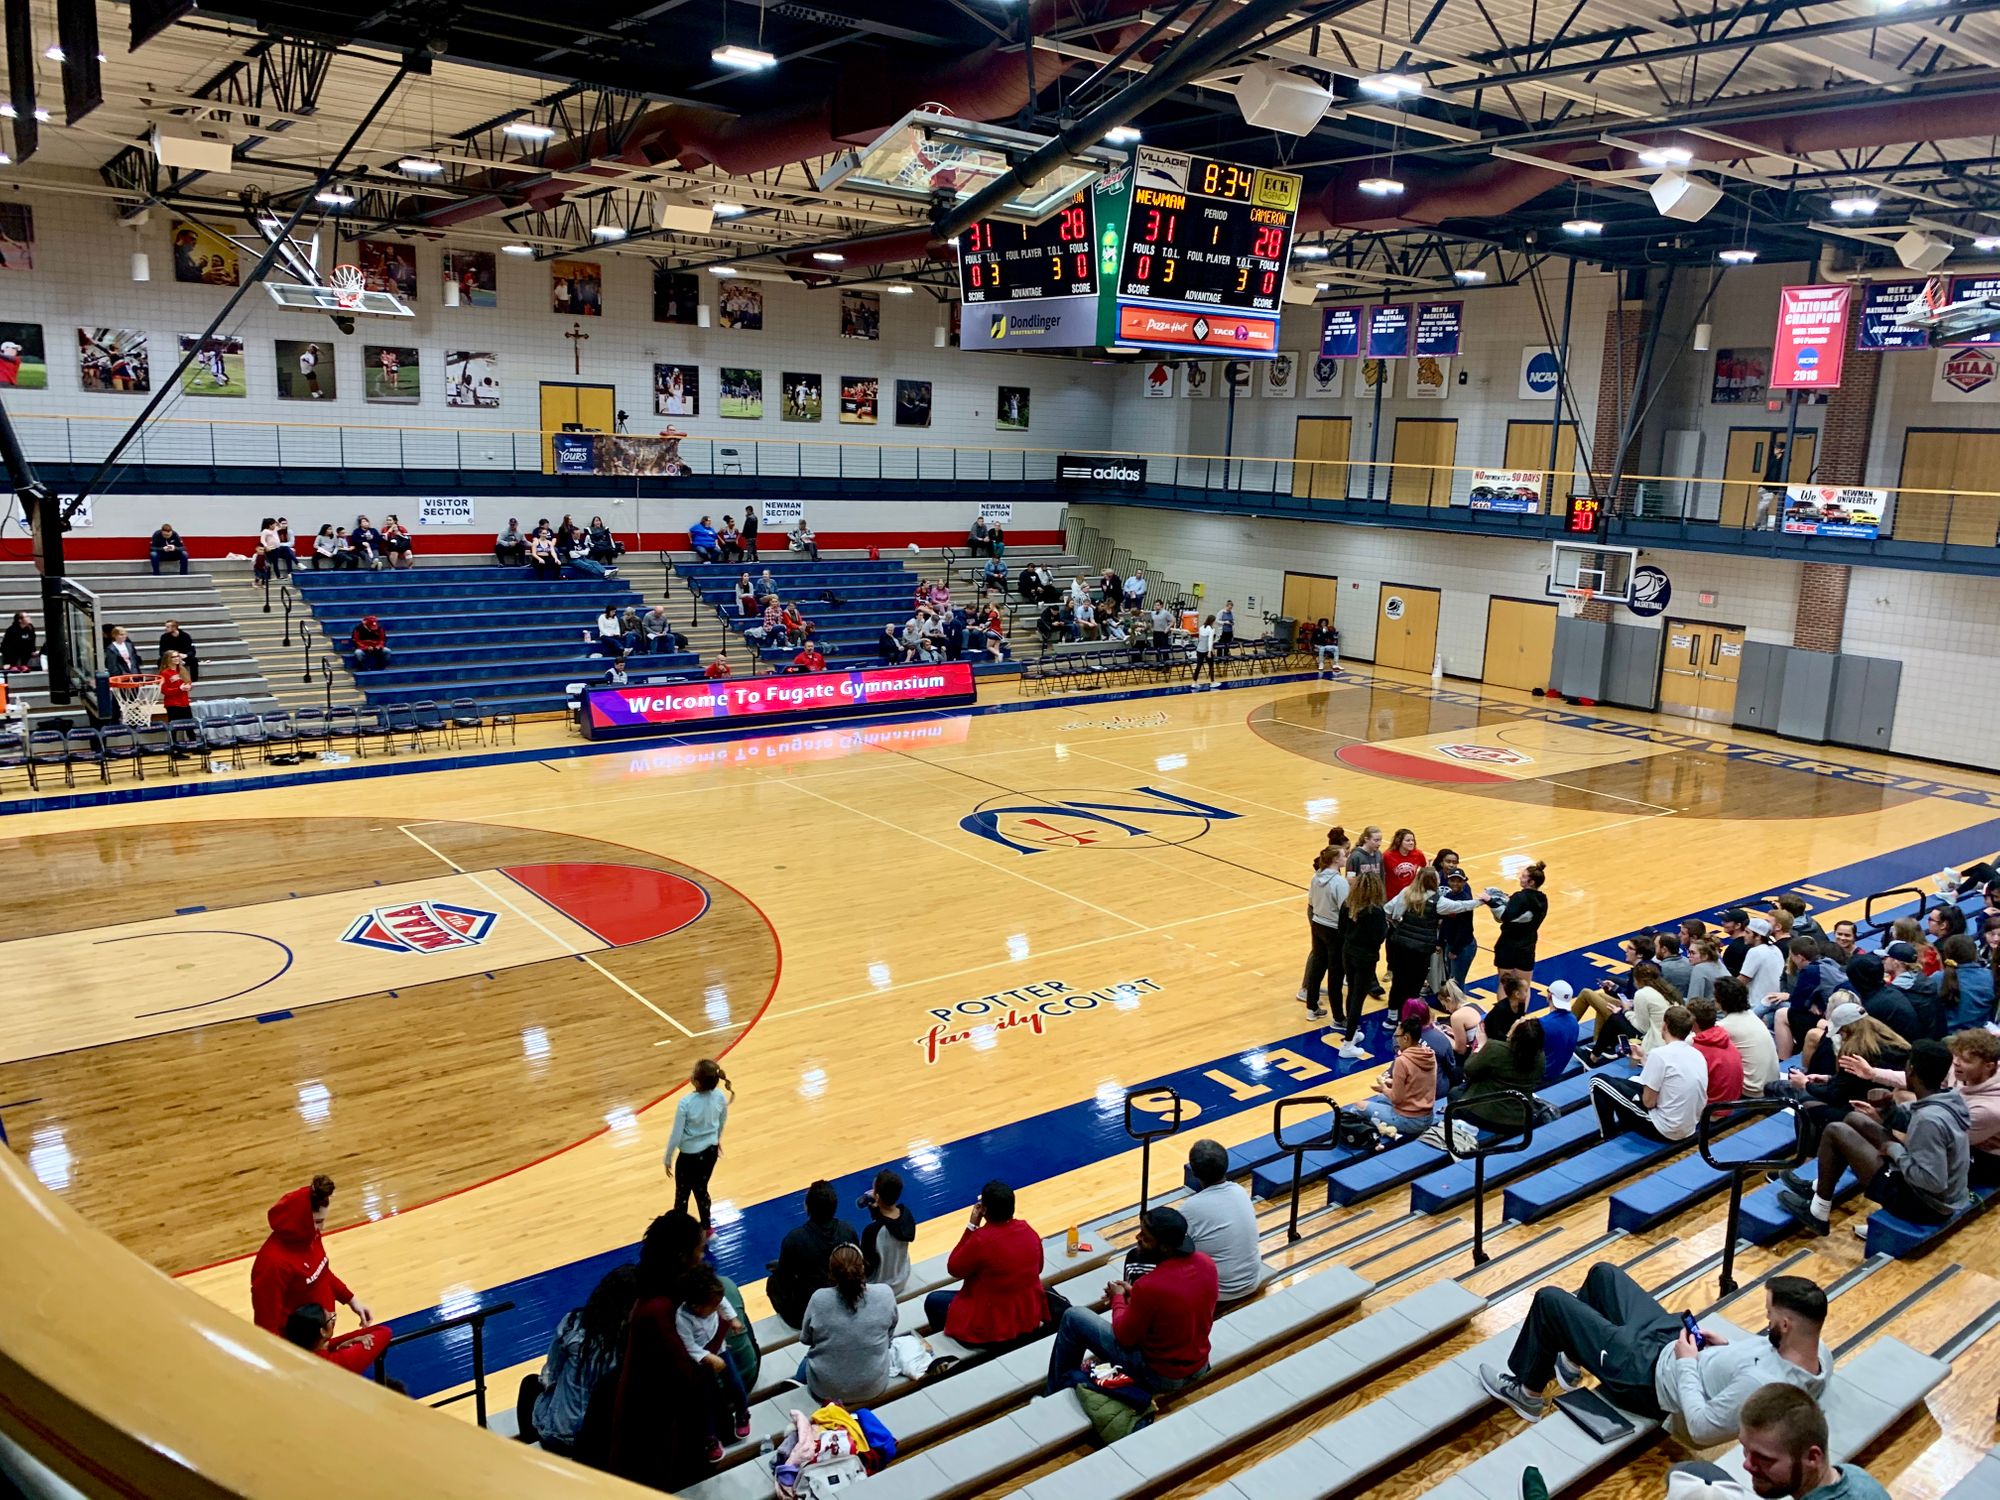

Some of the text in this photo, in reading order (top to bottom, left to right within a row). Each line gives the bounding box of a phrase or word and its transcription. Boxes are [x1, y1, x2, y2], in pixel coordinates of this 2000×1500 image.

[1141, 152, 1187, 168] VILLAGE
[1204, 163, 1251, 197] 8:34
[1264, 177, 1290, 193] ECK
[1136, 189, 1185, 210] NEWMAN
[1262, 191, 1287, 202] AGENCY
[1204, 208, 1228, 221] PERIOD
[1250, 208, 1286, 226] CAMERON
[1061, 208, 1085, 240] 28
[1146, 210, 1175, 242] 31
[970, 223, 991, 251] 31
[1212, 225, 1219, 245] 1
[1254, 226, 1282, 257] 28
[1006, 248, 1042, 260] FOUL PLAYER
[1047, 245, 1064, 256] T.O.L.
[1069, 242, 1089, 254] FOULS
[1132, 243, 1155, 255] FOULS
[1162, 247, 1180, 259] T.O.L.
[965, 254, 982, 265] FOULS
[1187, 251, 1231, 265] FOUL PLAYER
[1236, 257, 1253, 268] T.O.L.
[1052, 257, 1062, 280] 3
[1077, 253, 1087, 278] 0
[1138, 256, 1150, 280] 0
[1163, 259, 1175, 282] 3
[1259, 259, 1279, 271] FOULS
[972, 265, 981, 287] 0
[991, 263, 1000, 285] 3
[1237, 269, 1248, 291] 3
[1071, 282, 1091, 294] SCORE
[1127, 283, 1150, 295] SCORE
[1263, 271, 1274, 294] 0
[968, 291, 985, 301] SCORE
[1011, 287, 1042, 298] ADVANTAGE
[1887, 286, 1914, 294] MEN'S
[1185, 290, 1222, 304] ADVANTAGE
[1253, 297, 1273, 309] SCORE
[1789, 300, 1840, 313] NATIONAL
[1010, 315, 1061, 330] Dondlinger
[1423, 312, 1456, 320] BASKETBALL
[1785, 312, 1841, 325] CHAMPION
[1146, 318, 1189, 332] Pizza Hut
[1213, 328, 1270, 339] TACO BELL
[1946, 361, 1994, 376] MIAA
[1529, 371, 1559, 383] NCAA
[559, 449, 588, 463] YOURS
[1093, 466, 1140, 481] adidas
[1474, 471, 1485, 480] NO
[1522, 473, 1541, 483] DAYS
[1800, 490, 1817, 501] We
[1837, 495, 1878, 505] UNIVERSITY
[1842, 489, 1874, 498] NEWMAN
[425, 499, 468, 507] VISITOR
[765, 501, 801, 509] NEWMAN
[1575, 500, 1599, 511] 8:34
[423, 508, 470, 516] SECTION
[766, 509, 801, 517] SECTION
[1572, 511, 1593, 530] 30
[1634, 600, 1663, 610] BASKETBALL
[629, 675, 945, 714] Welcome To Fugate Gymnasium
[1336, 673, 1582, 724] NEWMAN
[384, 904, 465, 950] MIAA
[930, 980, 1075, 1022] POTTER
[1039, 978, 1163, 1016] COURT
